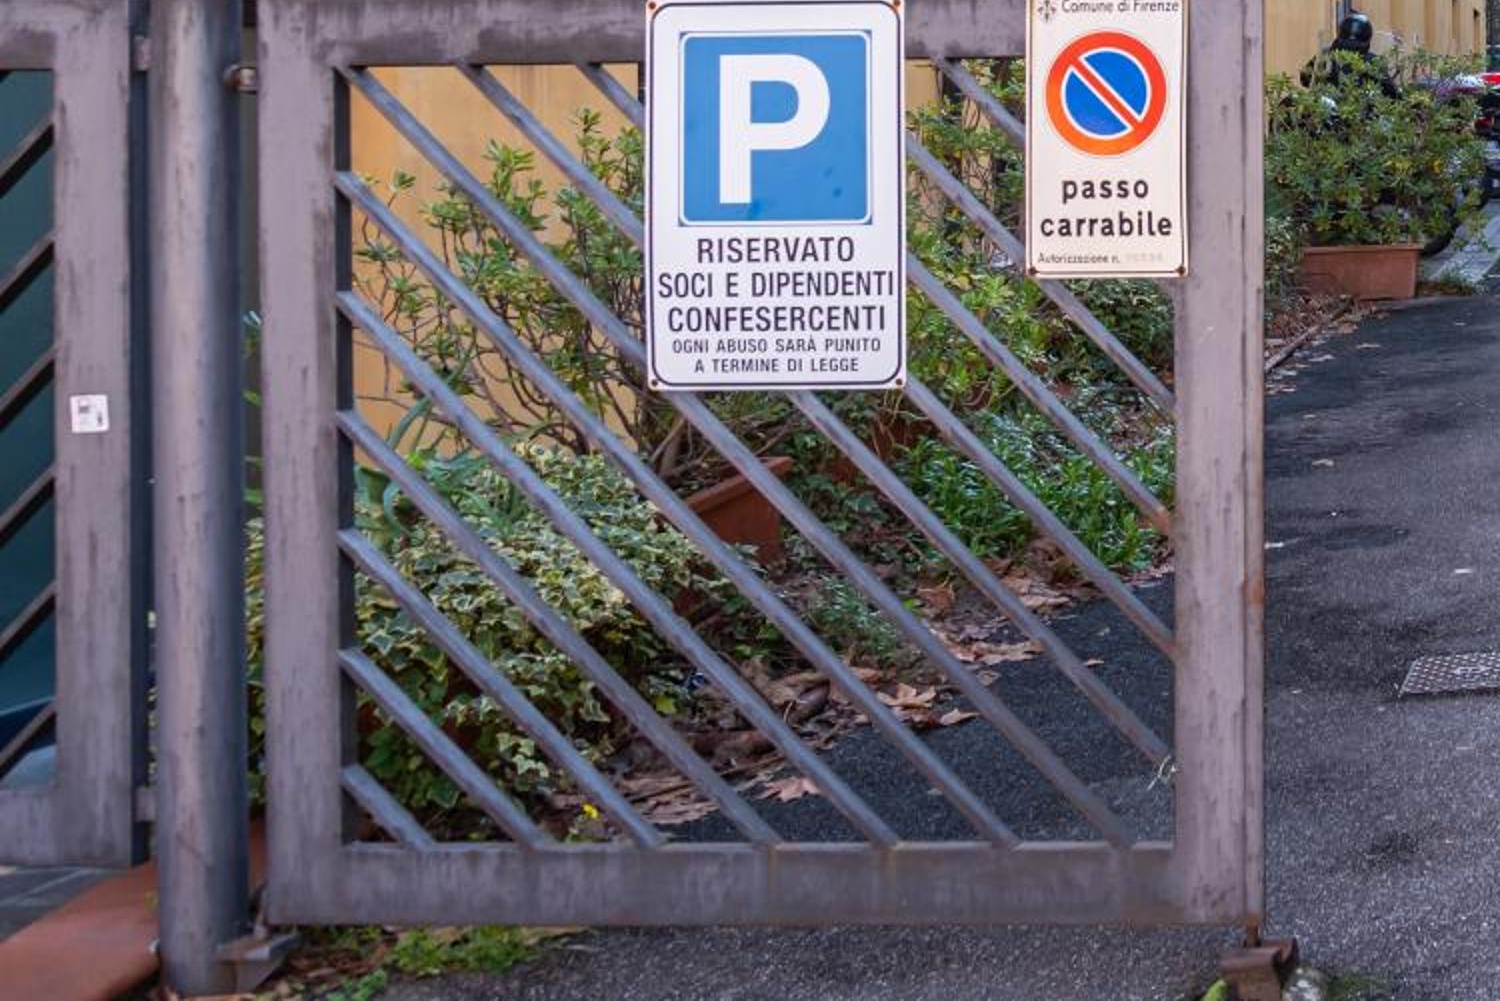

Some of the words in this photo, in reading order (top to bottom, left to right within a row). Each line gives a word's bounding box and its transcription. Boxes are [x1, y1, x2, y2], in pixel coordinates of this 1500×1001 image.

[720, 54, 831, 204] P
[1061, 179, 1149, 204] passo
[1040, 210, 1172, 237] carrabile
[697, 236, 855, 264] RISERVATO
[658, 272, 713, 298] SOCI
[725, 272, 739, 298] E
[751, 270, 894, 298] DIPENDENTI
[668, 305, 886, 333] CONFESERCENTI
[673, 338, 709, 354] OGNI
[716, 338, 768, 353] ABUSO
[775, 334, 817, 353] SARÀ
[825, 337, 881, 352] PUNITO
[694, 358, 705, 374] A
[711, 358, 779, 373] TERMINE
[787, 358, 803, 373] DI
[811, 357, 859, 372] LEGGE
